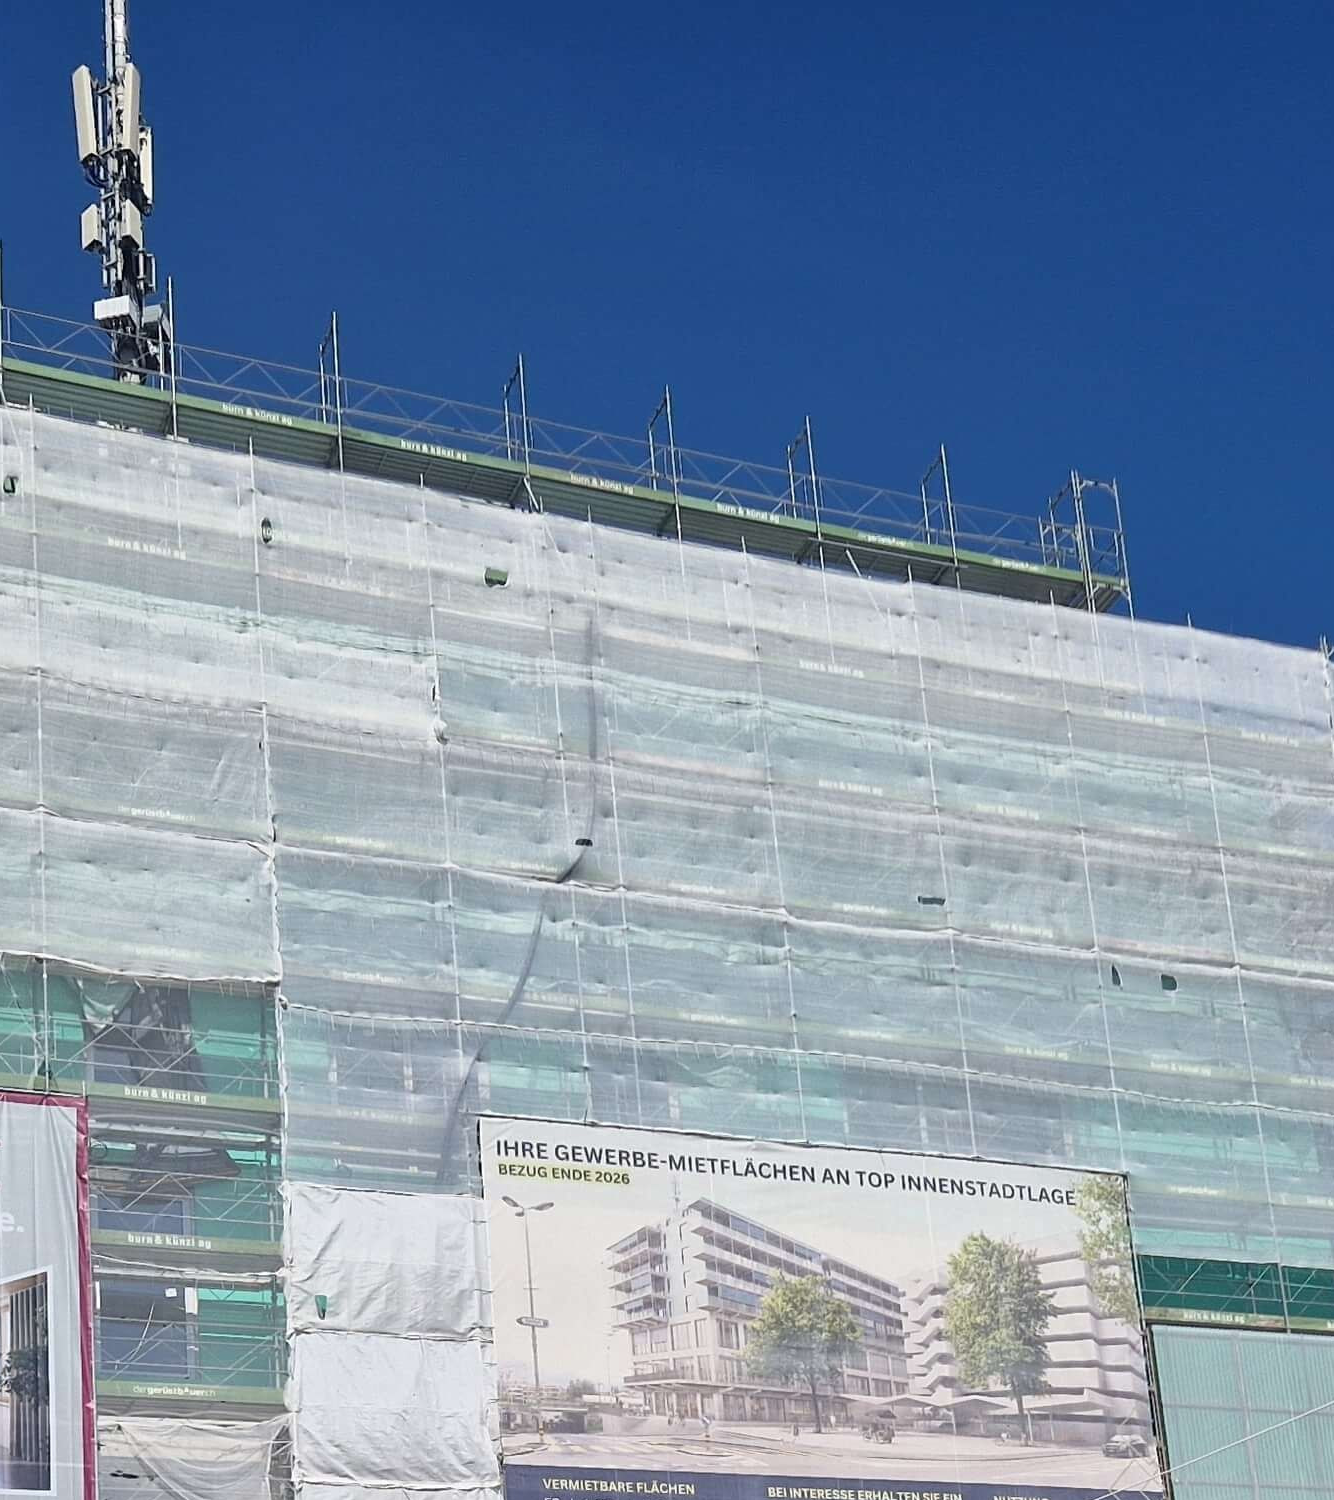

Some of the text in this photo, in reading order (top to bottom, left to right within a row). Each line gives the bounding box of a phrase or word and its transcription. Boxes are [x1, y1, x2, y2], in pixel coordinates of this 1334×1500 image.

[496, 1140, 1076, 1206] IHRE GEWERBE-MIETFLÄCHEN AN TOP INNENSTADTLAGE
[498, 1164, 630, 1185] BEZUG ENDE 2026
[543, 1479, 695, 1495] VERMIETBARE FLÄCHEN
[768, 1487, 787, 1498] BEI
[789, 1488, 855, 1500] INTERESSE
